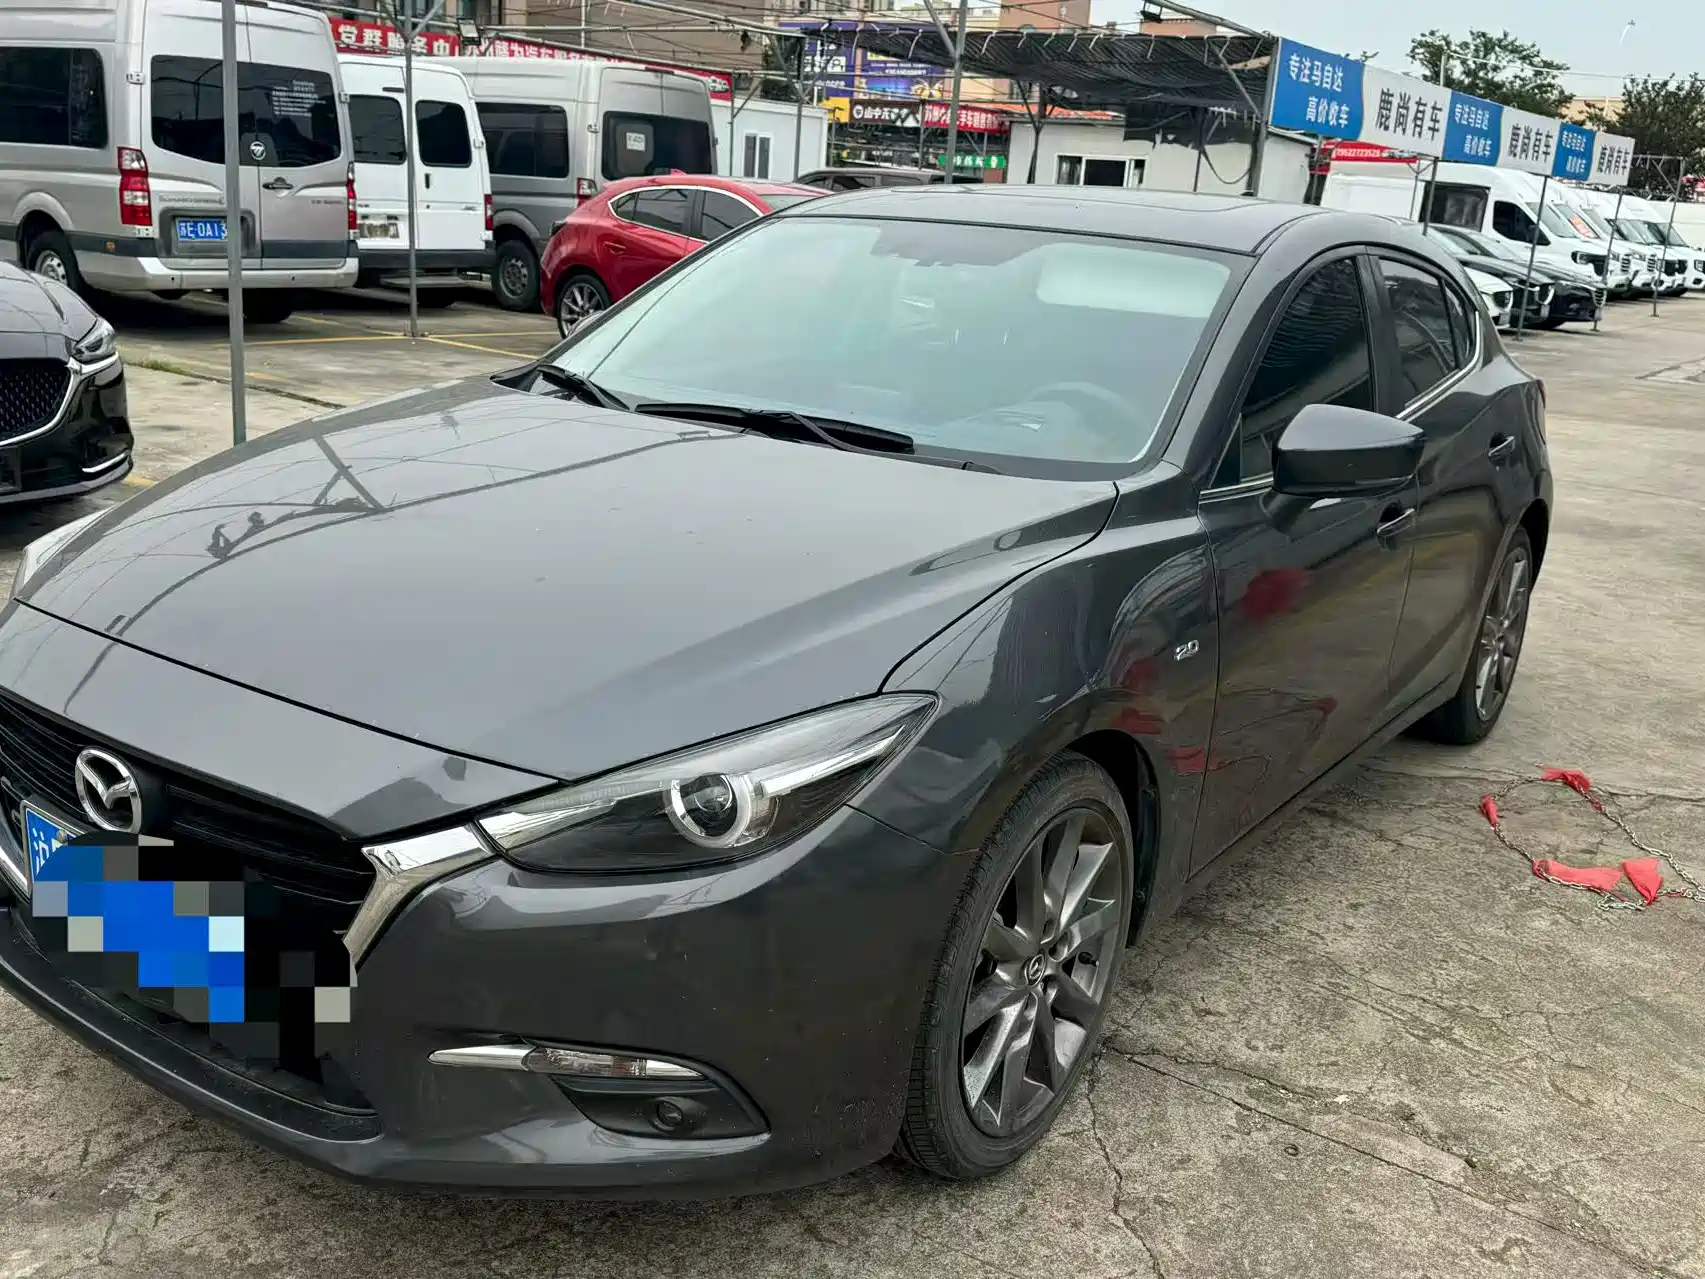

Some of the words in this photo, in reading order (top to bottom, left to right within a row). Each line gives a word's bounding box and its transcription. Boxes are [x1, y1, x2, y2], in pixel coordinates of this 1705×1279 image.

[1288, 53, 1343, 92] 专注马自达
[1306, 95, 1350, 128] 高价收车
[1375, 88, 1443, 142] 鹿尚有车
[1454, 103, 1490, 130] 专注马自达
[1463, 134, 1492, 158] 高价收车
[1508, 123, 1553, 162] 鹿尚有车
[1597, 144, 1630, 176] 鹿尚有车
